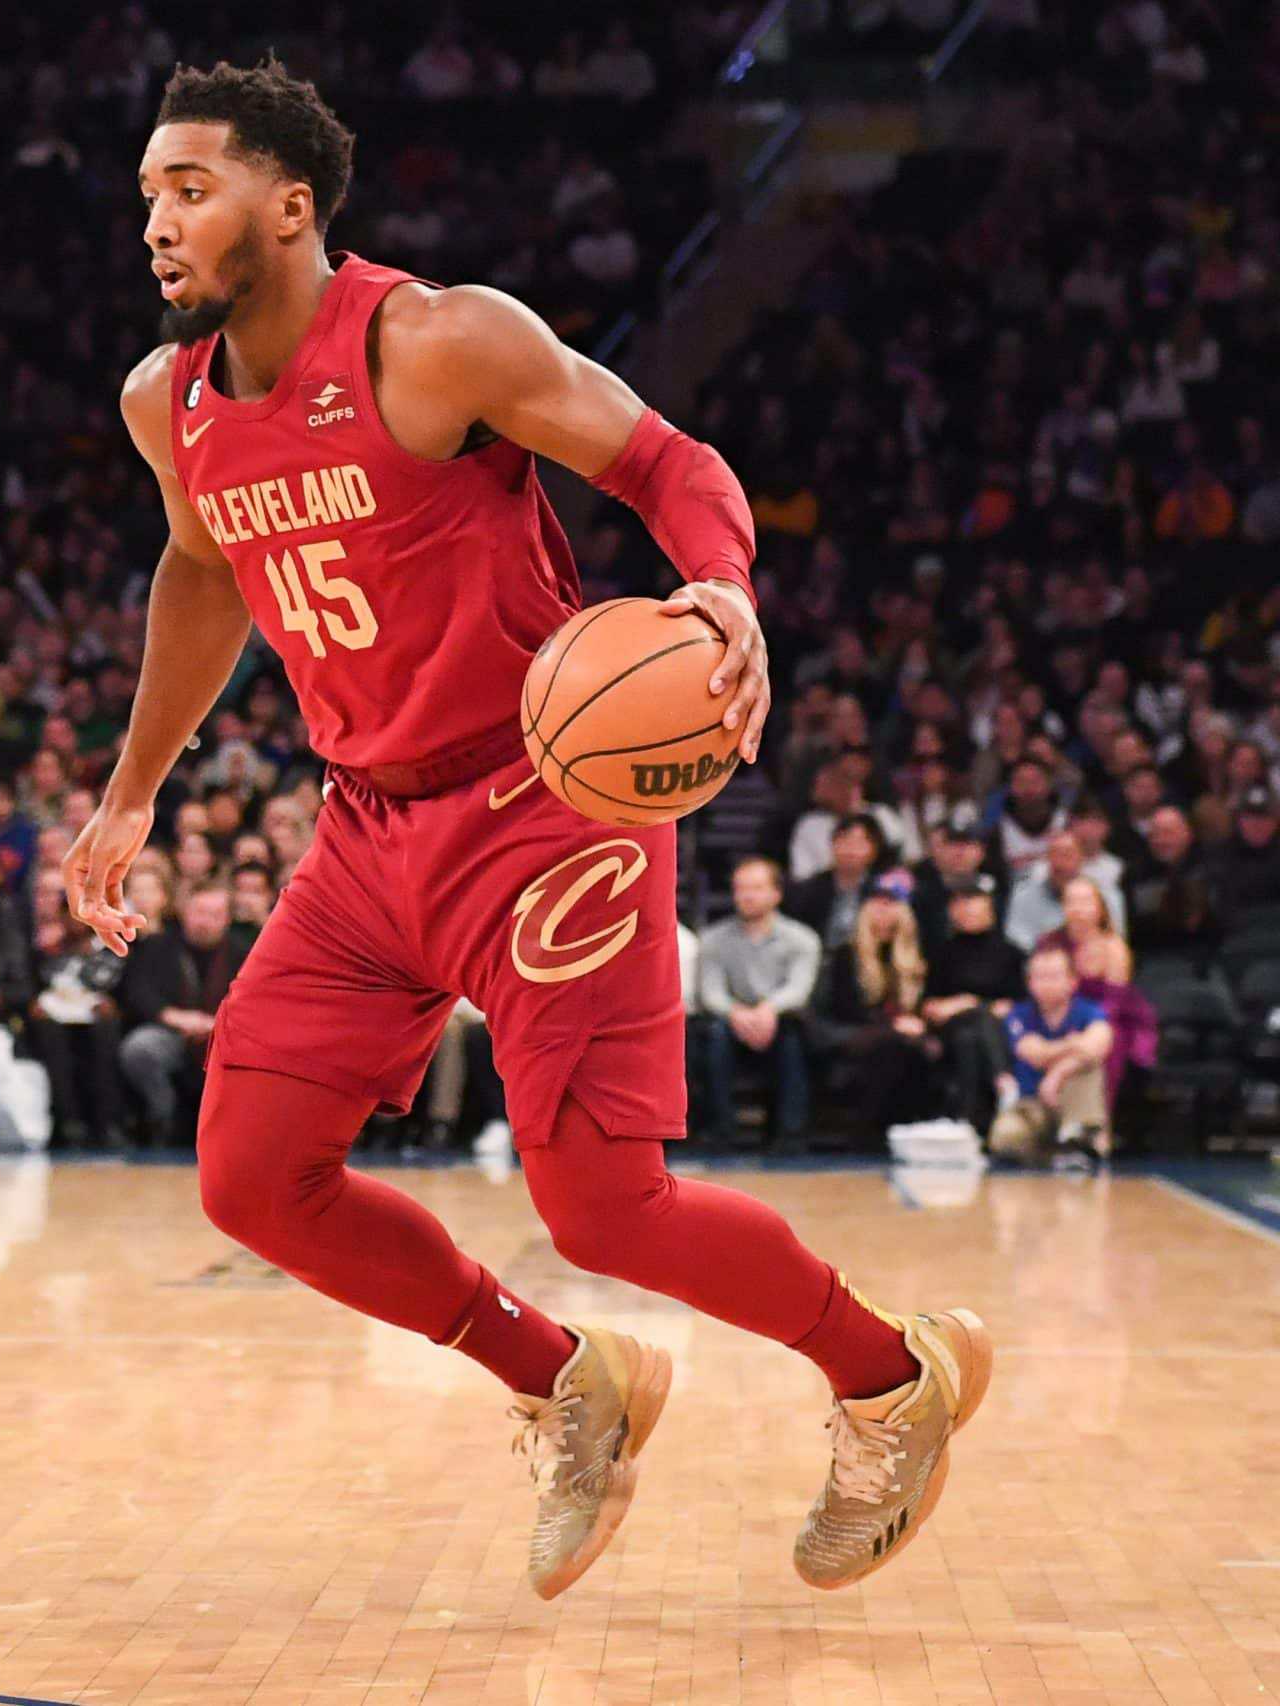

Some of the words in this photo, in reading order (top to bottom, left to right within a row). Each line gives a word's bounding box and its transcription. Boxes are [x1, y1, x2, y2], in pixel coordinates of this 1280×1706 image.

[188, 379, 203, 409] 6
[307, 406, 355, 428] CLIFFS
[196, 464, 378, 546] CLEVELAND
[264, 540, 380, 659] 45
[630, 747, 741, 797] Wilso
